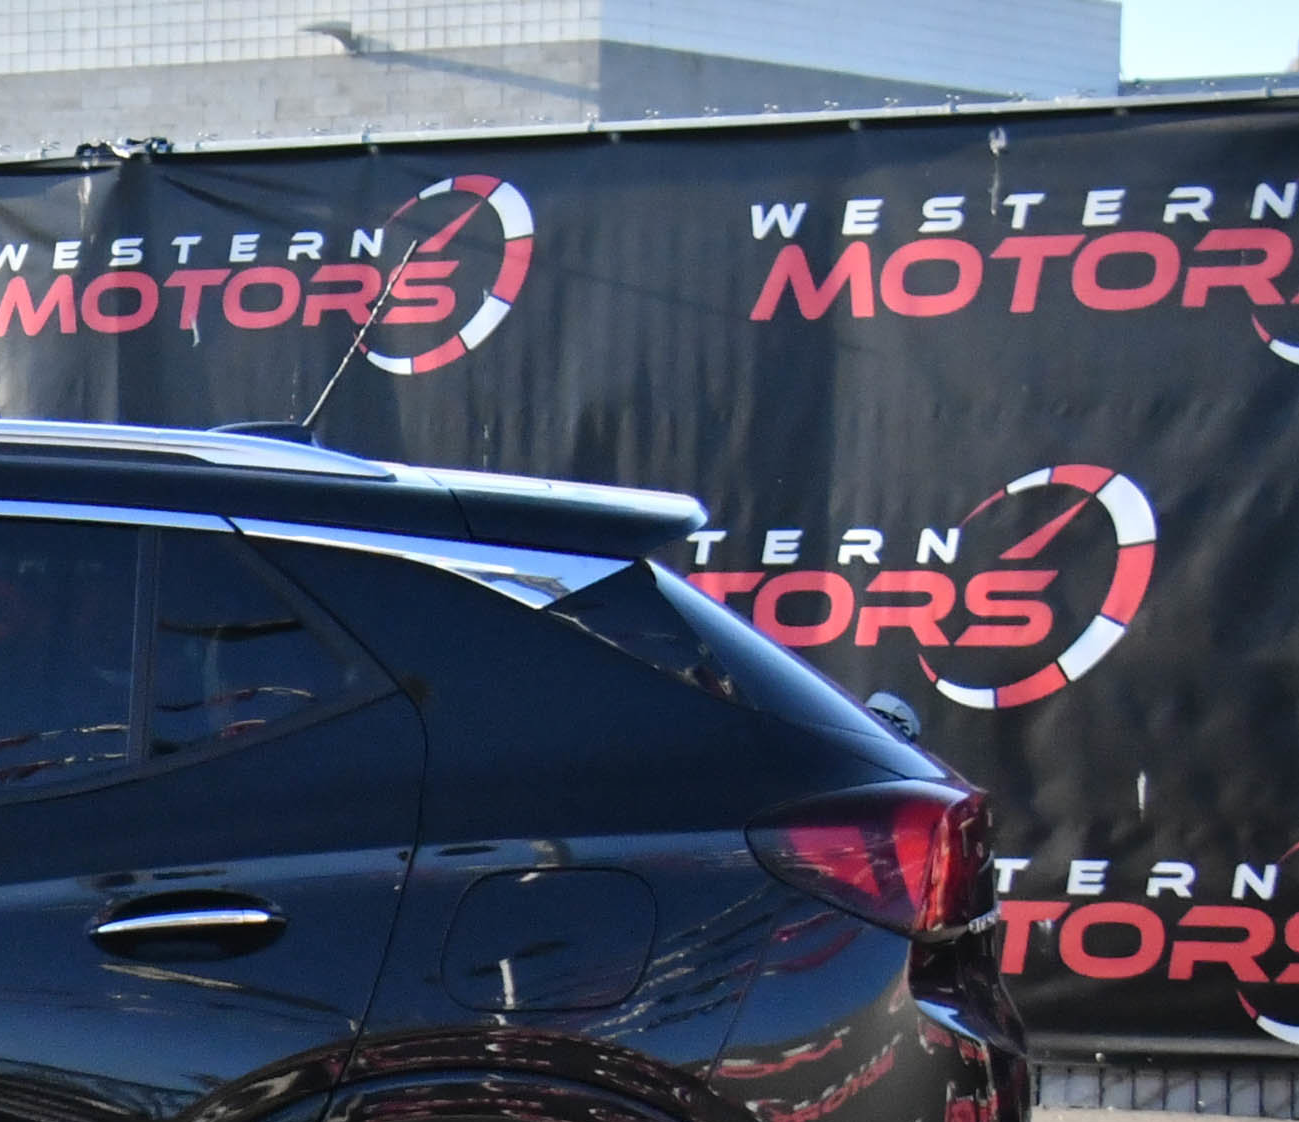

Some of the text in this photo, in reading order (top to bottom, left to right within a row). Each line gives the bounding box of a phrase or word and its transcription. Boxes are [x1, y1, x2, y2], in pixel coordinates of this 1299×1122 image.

[750, 181, 1298, 241] WESTERN
[748, 227, 1299, 322] MOTOR
[685, 526, 962, 566] TERN
[686, 568, 1059, 648] TORS
[993, 855, 1279, 900] TERN
[999, 899, 1299, 985] TOR
